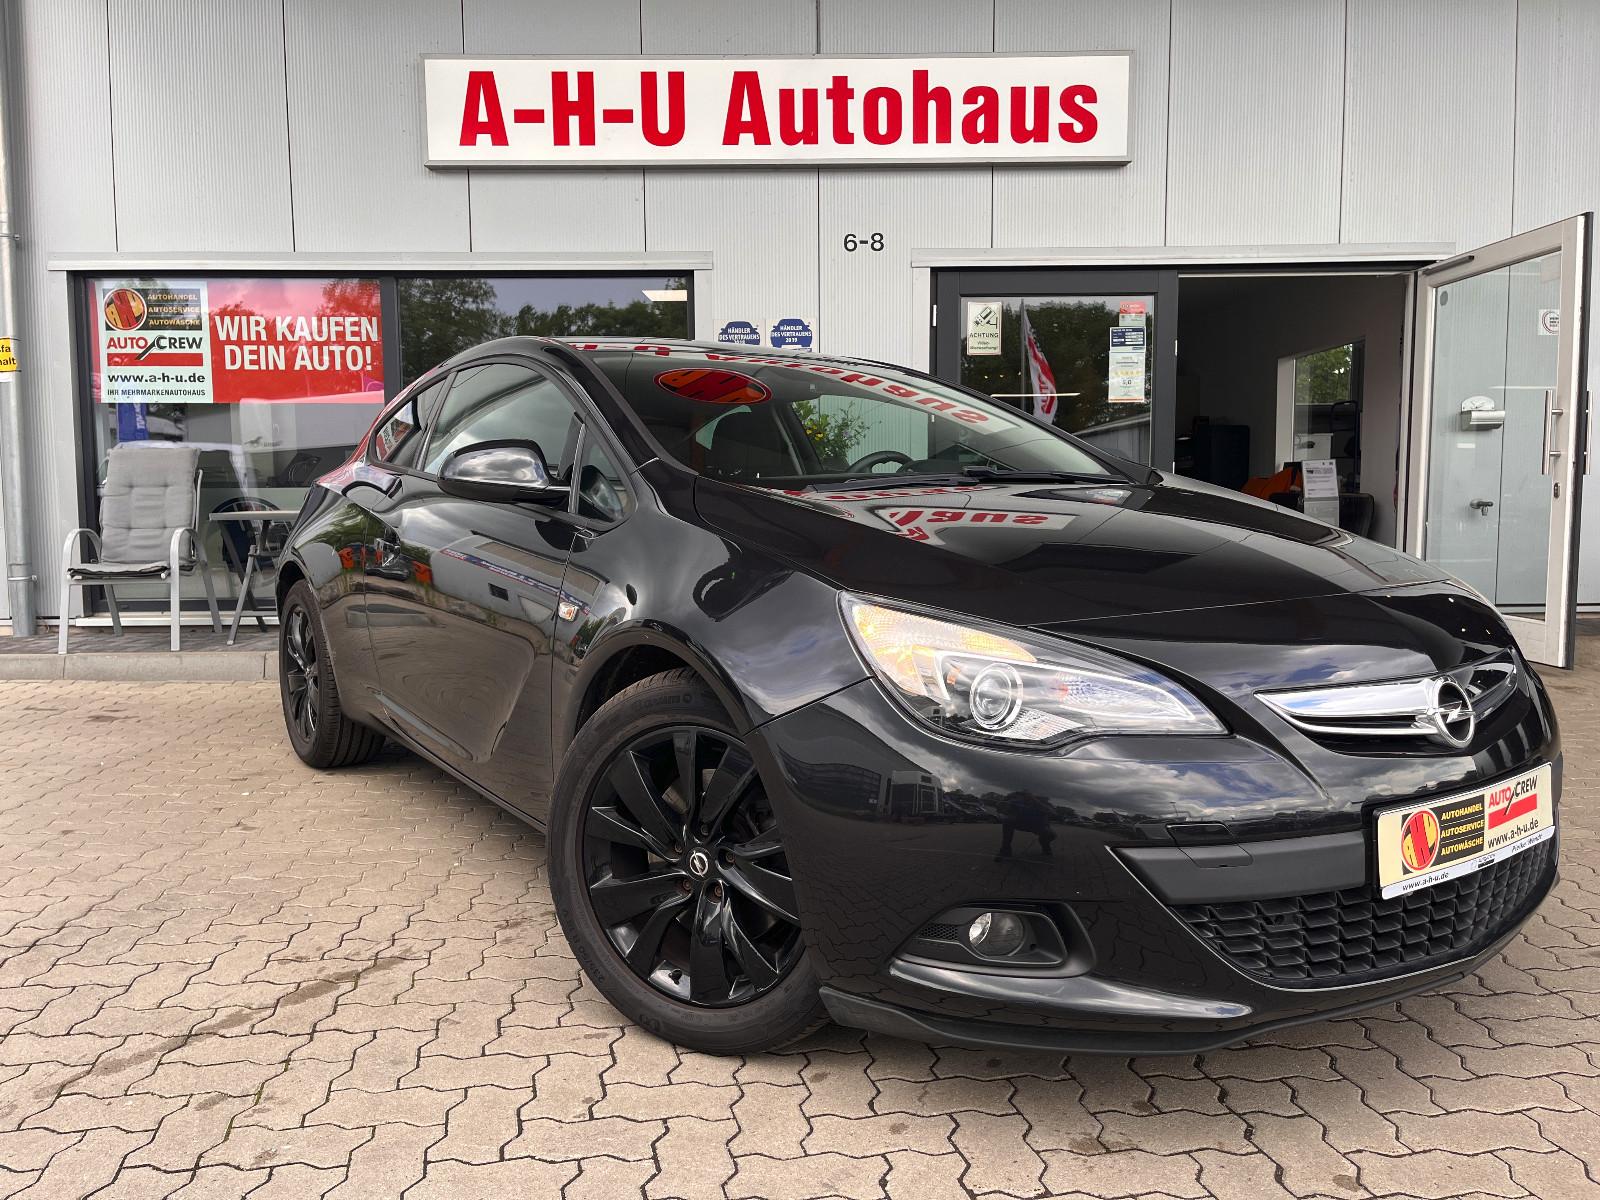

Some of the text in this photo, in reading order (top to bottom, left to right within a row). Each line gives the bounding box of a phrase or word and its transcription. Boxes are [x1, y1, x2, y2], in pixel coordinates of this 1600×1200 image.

[459, 69, 1098, 146] A-H-U Autohaus
[843, 233, 884, 251] 6-8
[214, 315, 379, 342] WIR KAUFEN
[727, 326, 751, 334] HÄNDLER
[0, 344, 11, 353] fa
[224, 345, 373, 371] DEIN AUTO!
[107, 372, 206, 383] www.a-h-u.de
[1488, 774, 1538, 809] AUTO CREW
[1440, 803, 1484, 821] AUTOHANDEL
[1440, 819, 1485, 839] AUTOSERVICE
[1487, 817, 1539, 849] www.a-h-u.de
[1440, 836, 1484, 856] AUTOWÄSCHE
[1402, 871, 1449, 891] www.a-h-u.de
